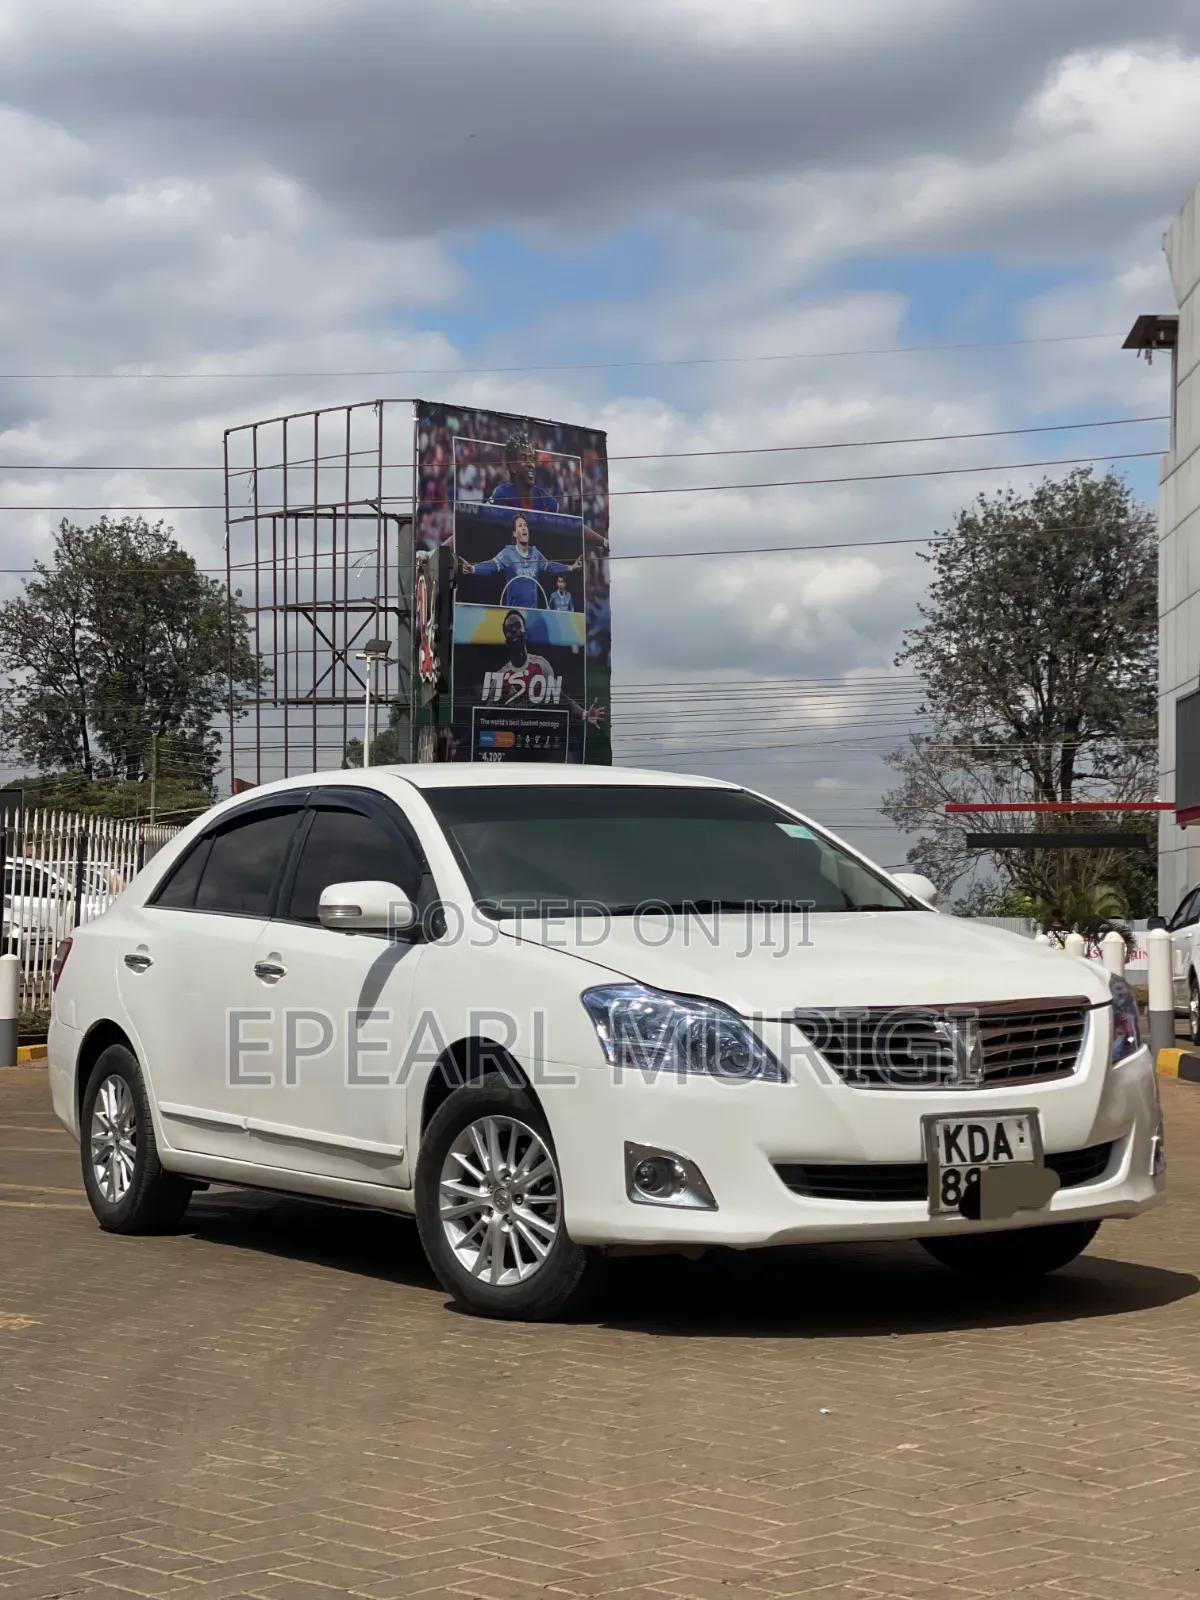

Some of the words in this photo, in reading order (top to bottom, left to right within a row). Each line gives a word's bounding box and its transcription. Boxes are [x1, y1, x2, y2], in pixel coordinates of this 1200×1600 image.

[481, 671, 528, 705] IT'S
[529, 674, 563, 704] ON
[480, 718, 490, 726] The
[943, 1122, 1014, 1164] KDA
